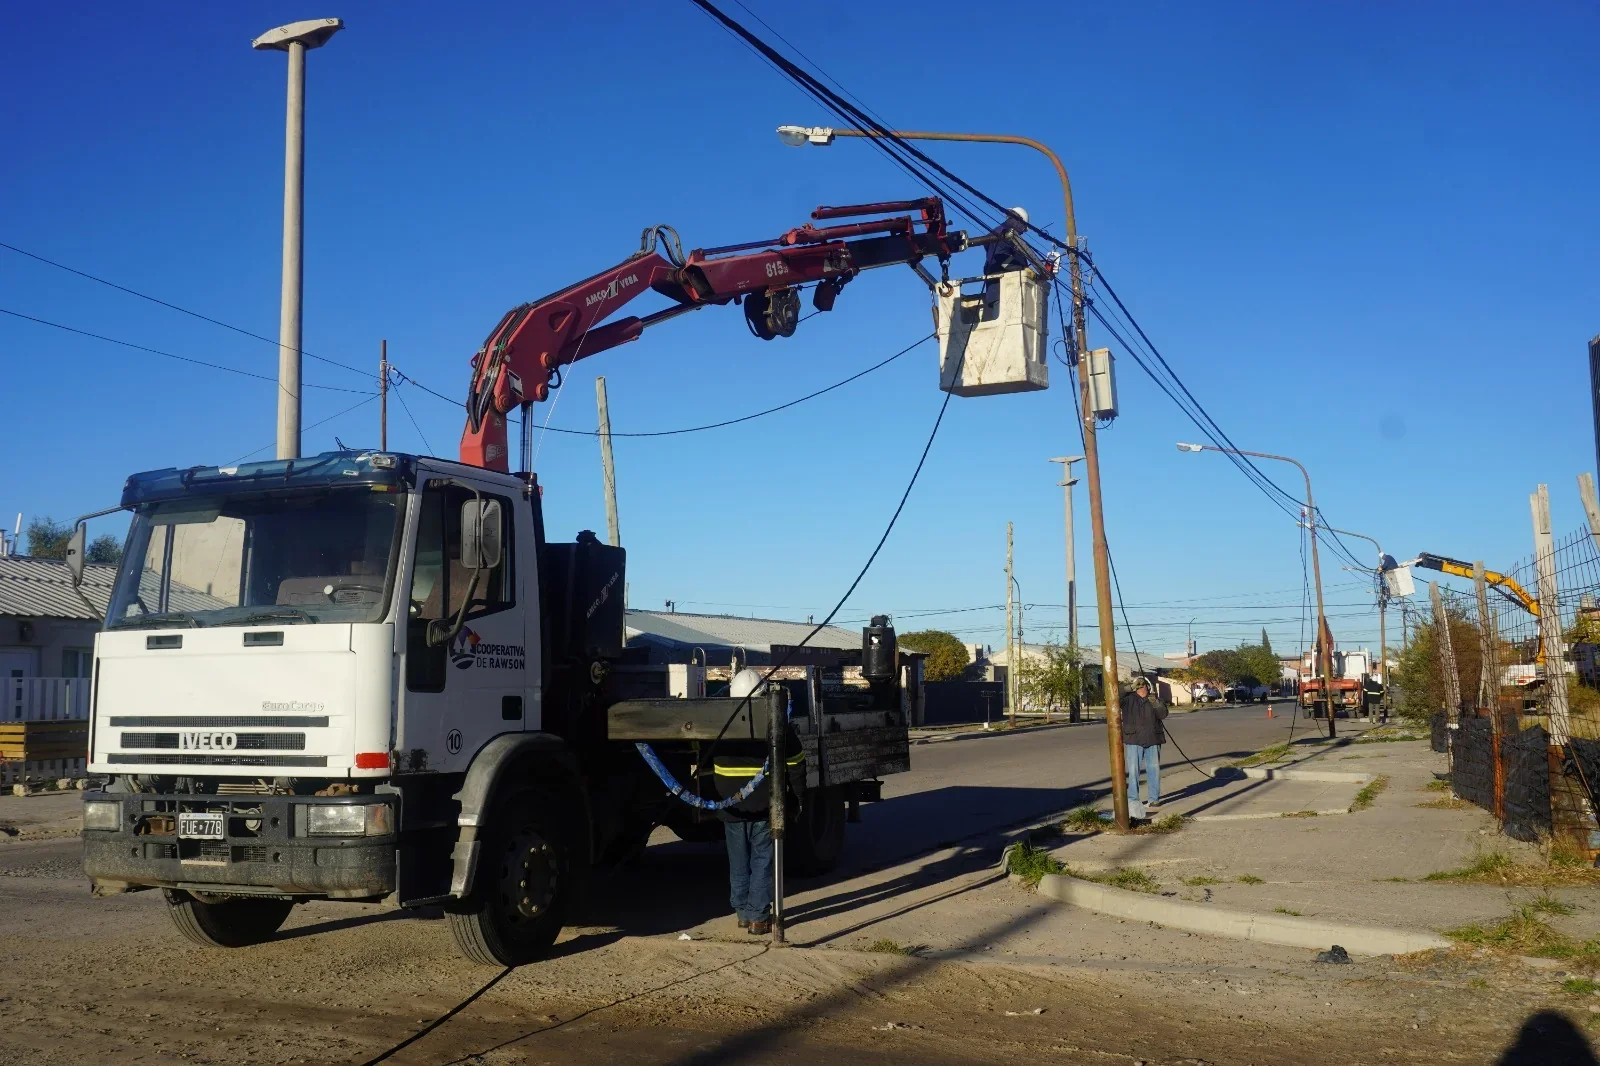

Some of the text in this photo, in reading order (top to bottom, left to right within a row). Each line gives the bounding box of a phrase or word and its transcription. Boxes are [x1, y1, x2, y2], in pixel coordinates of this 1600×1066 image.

[766, 260, 783, 278] 815
[585, 289, 607, 307] AMCO
[476, 643, 525, 657] COOPERATIVA
[476, 657, 525, 670] DE RAWSON
[179, 732, 238, 750] IVECO
[449, 733, 461, 750] 10
